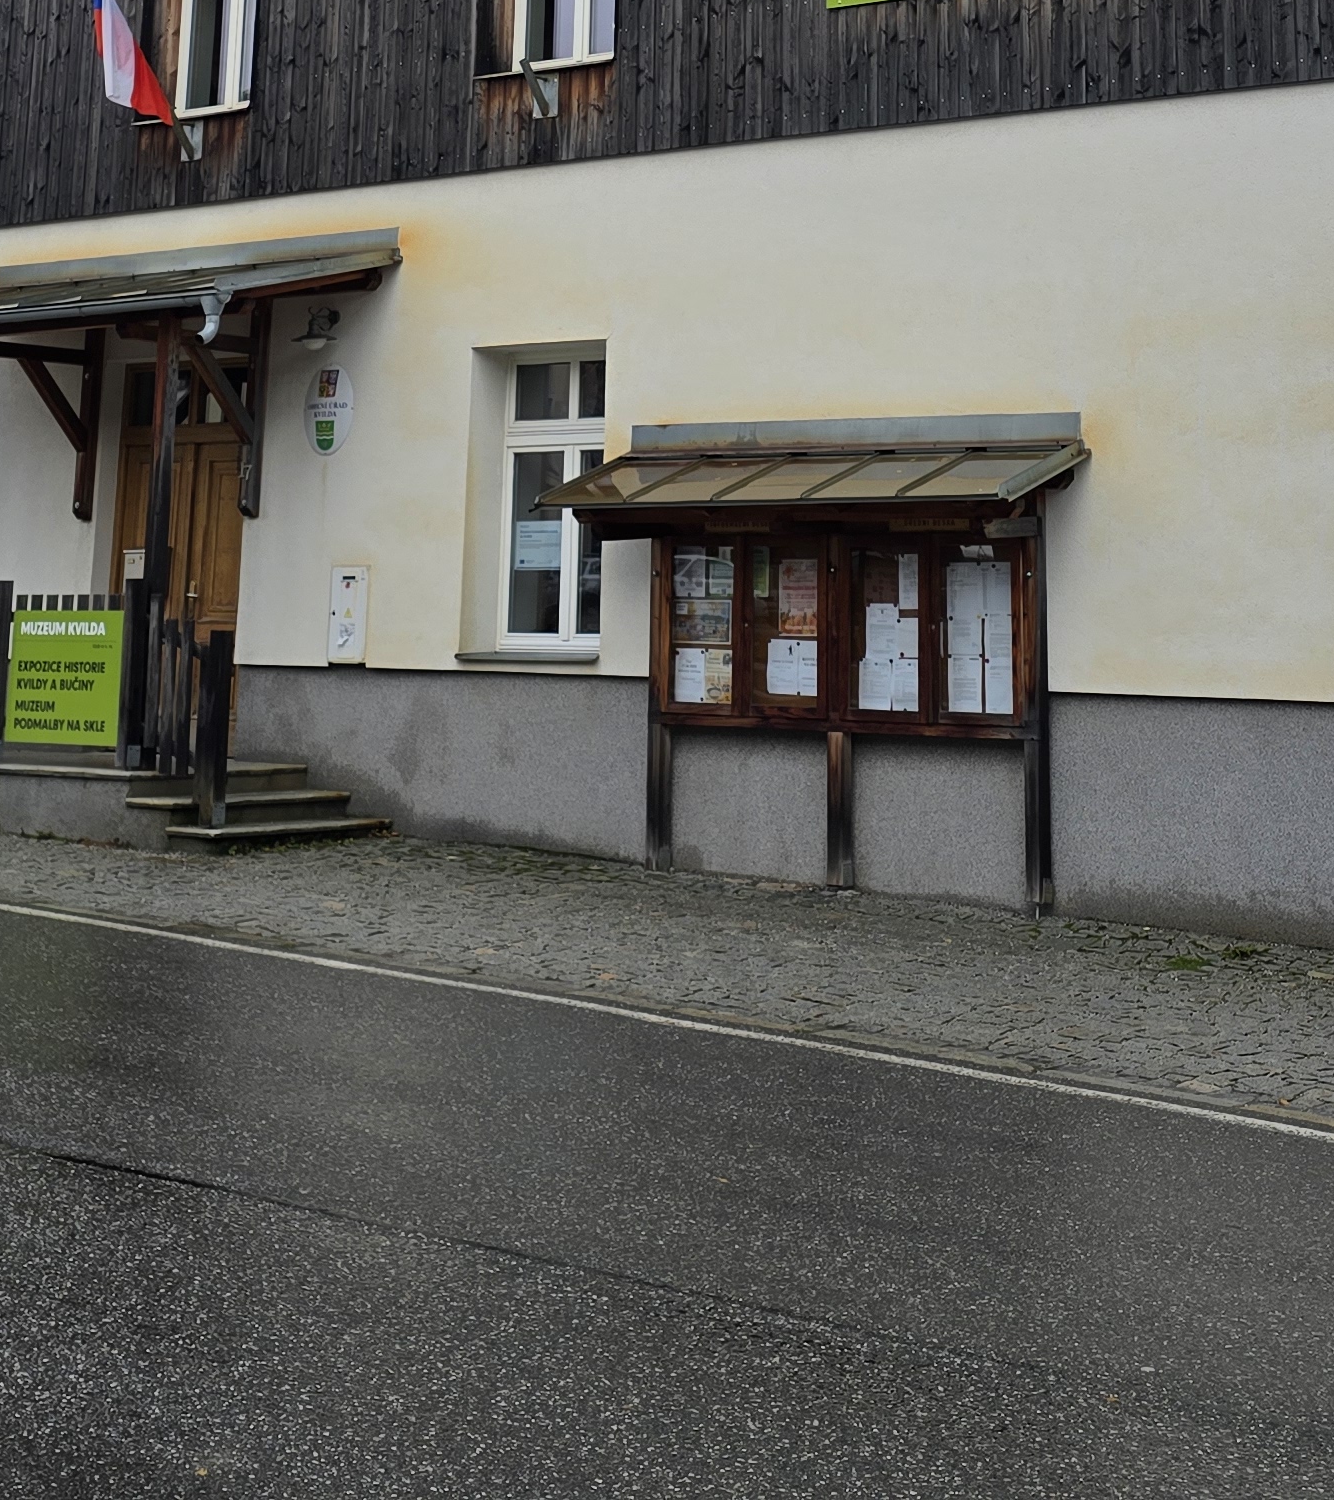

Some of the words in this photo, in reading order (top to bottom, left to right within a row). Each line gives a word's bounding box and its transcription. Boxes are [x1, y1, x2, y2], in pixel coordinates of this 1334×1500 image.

[238, 461, 252, 480] 17
[20, 622, 66, 636] MUZEUM
[68, 622, 106, 636] KVILDA
[17, 660, 61, 673] EXPOZICE
[64, 661, 106, 673] HISTORIE
[16, 678, 48, 690] KVILDY
[50, 679, 57, 691] A
[59, 676, 95, 691] BUČINY
[14, 700, 55, 712] MUZEUM
[13, 717, 65, 731] PODMALBY
[67, 719, 80, 731] NA
[83, 720, 105, 732] SKLE
